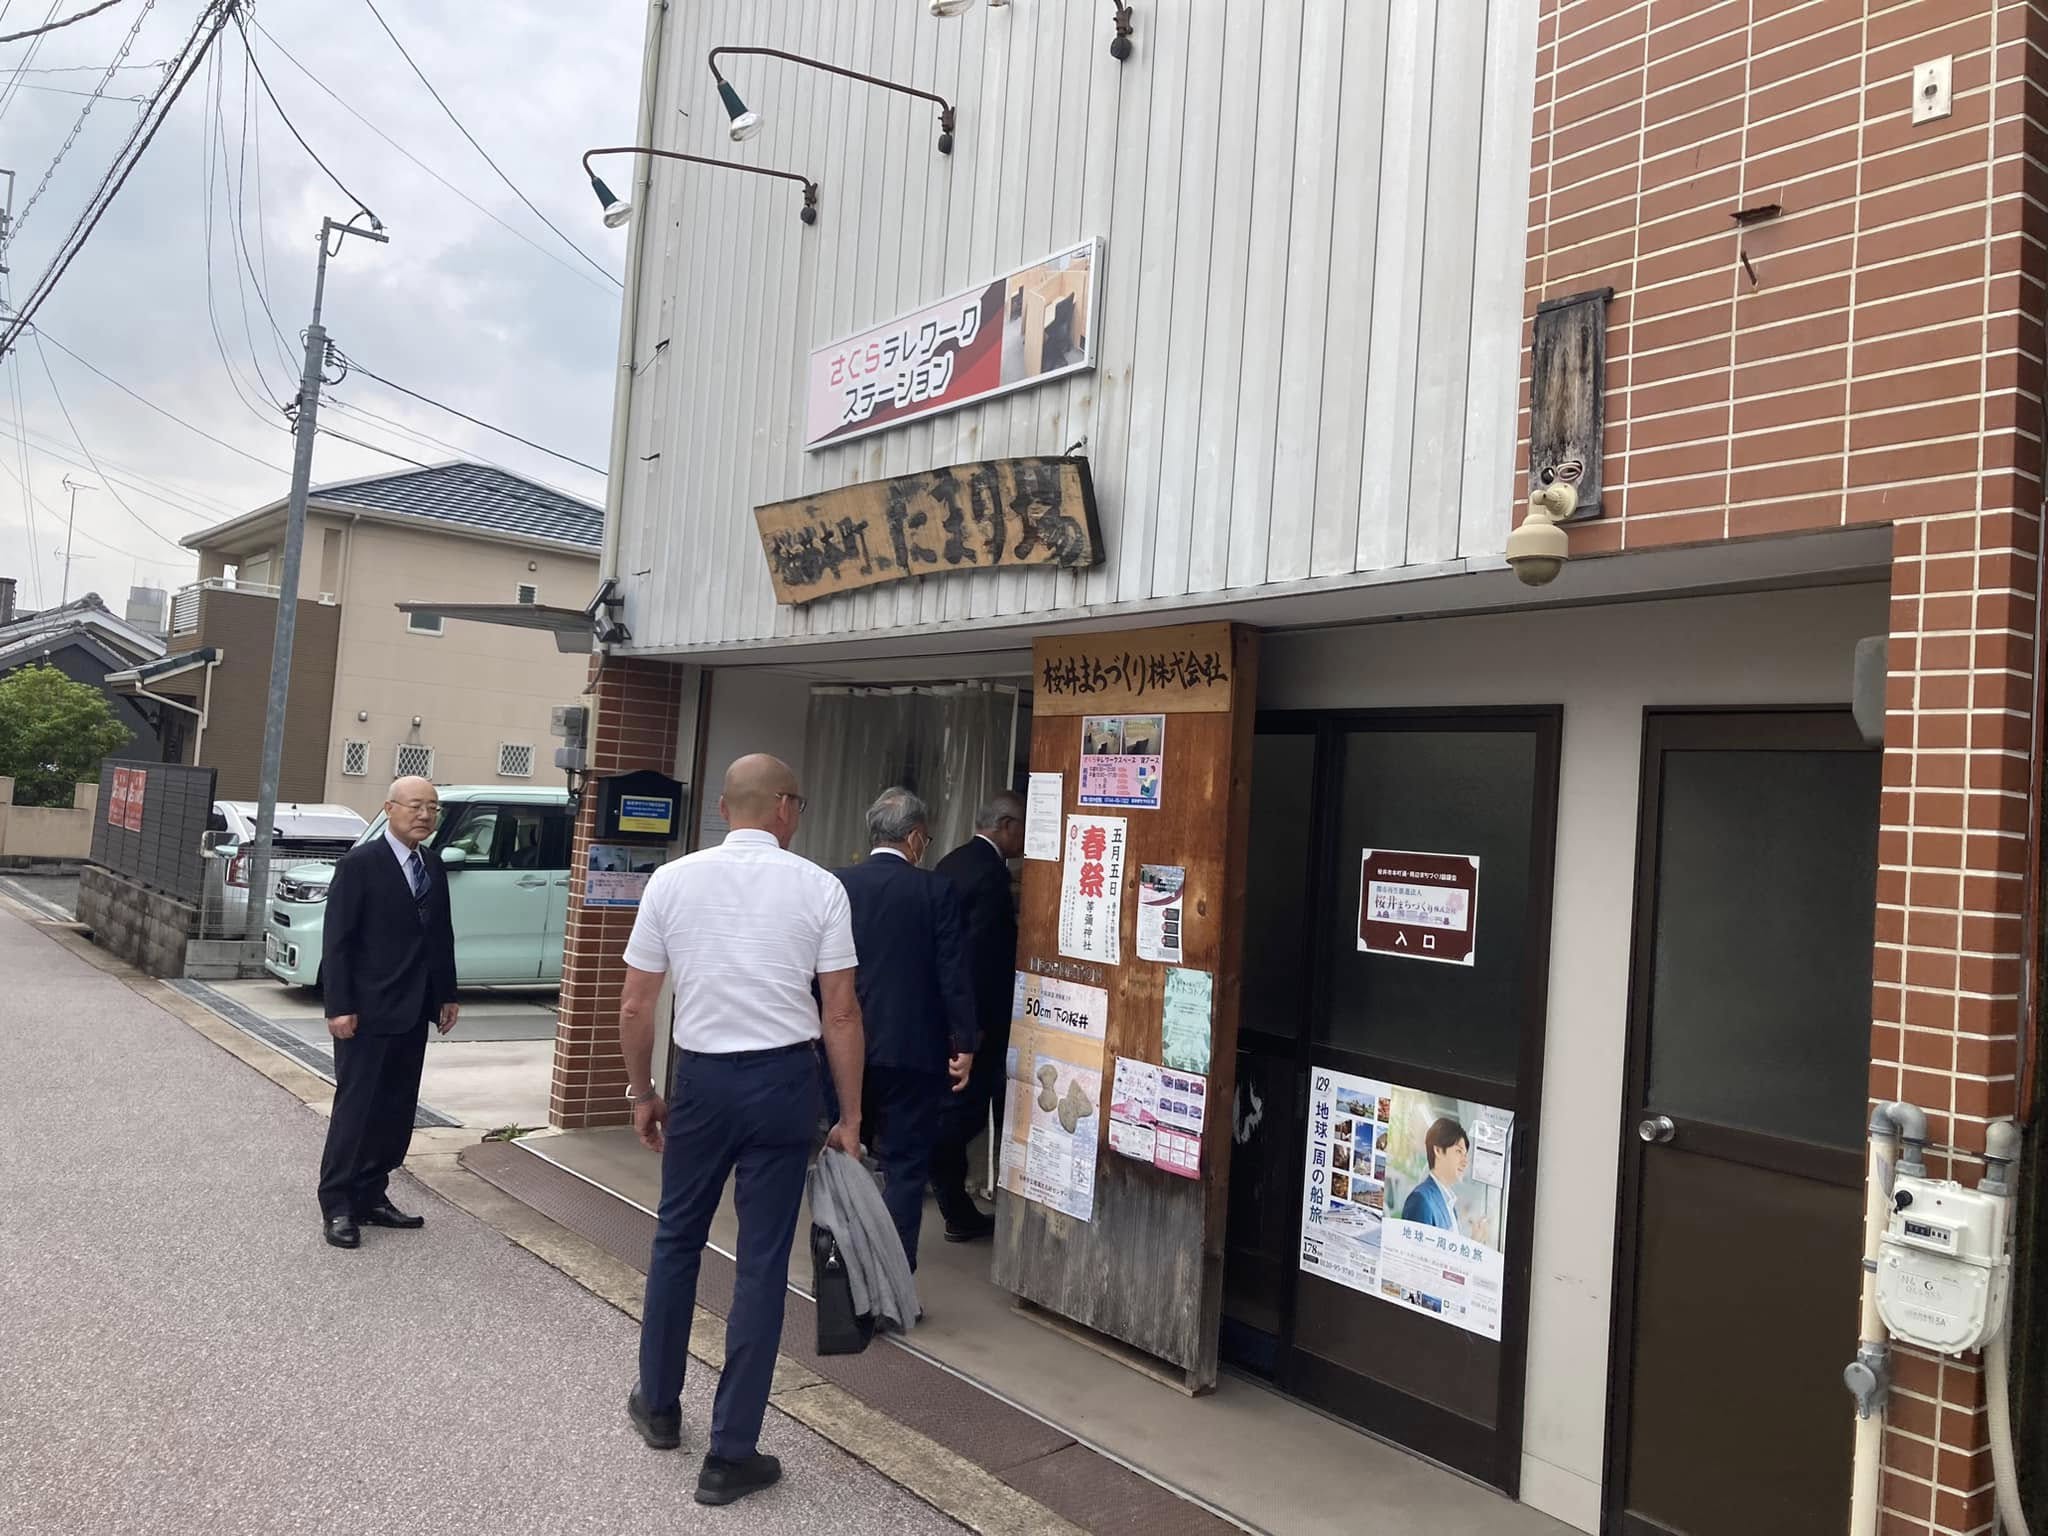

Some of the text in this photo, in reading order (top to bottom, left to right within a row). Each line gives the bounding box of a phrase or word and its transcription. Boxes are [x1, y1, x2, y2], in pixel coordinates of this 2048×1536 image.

[830, 305, 979, 386] さくらテレワーク
[843, 352, 953, 420] ステーション
[1042, 651, 1228, 697] 桜井まちづくり株式会社
[1079, 825, 1106, 898] 春祭
[1109, 828, 1122, 896] 五月五日
[1395, 931, 1435, 949] 入口
[1025, 998, 1089, 1029] 50cm 下の桜井
[1315, 1075, 1330, 1092] 129
[1308, 1101, 1330, 1225] 地球一周の船旅
[1401, 1226, 1483, 1262] 地球一周の船旅
